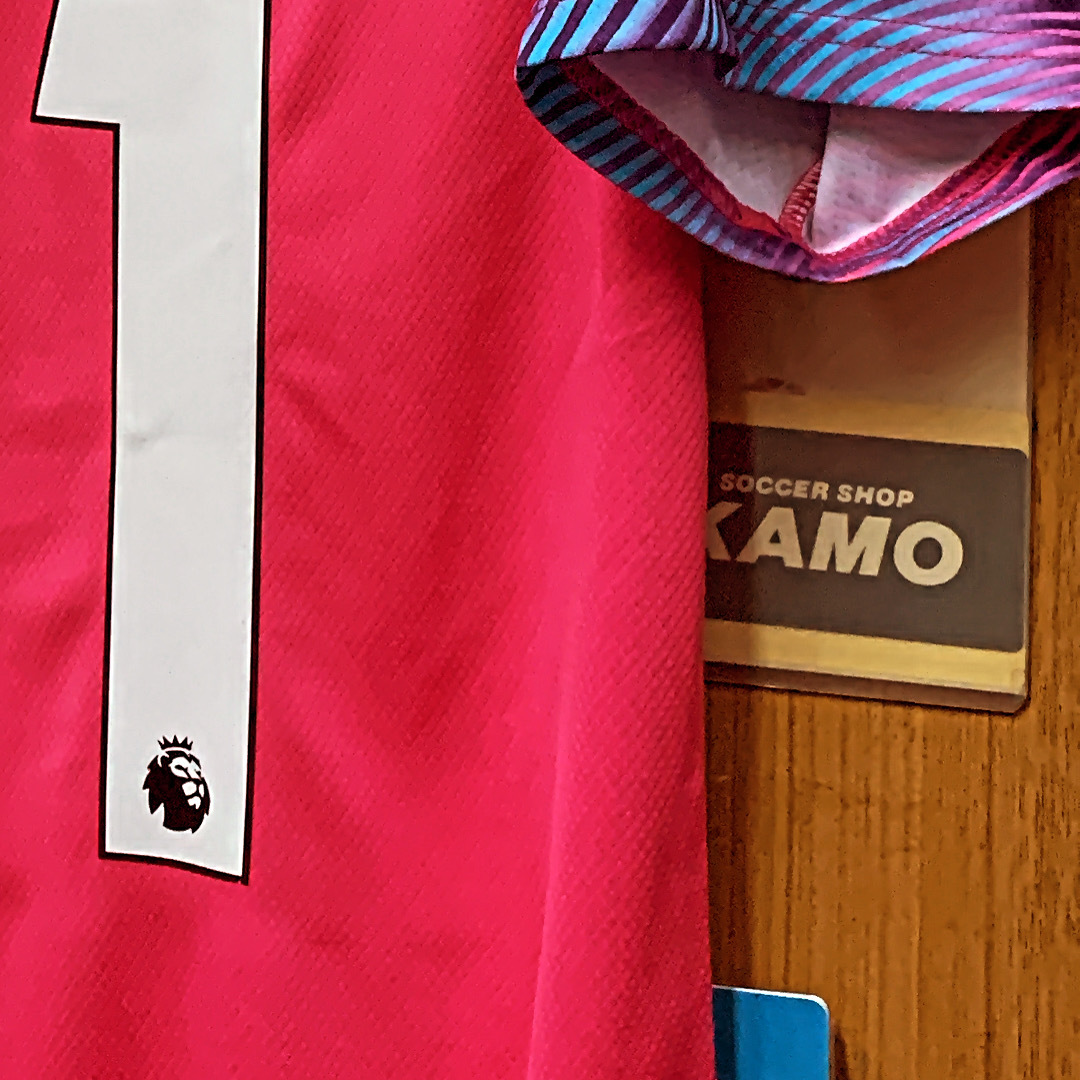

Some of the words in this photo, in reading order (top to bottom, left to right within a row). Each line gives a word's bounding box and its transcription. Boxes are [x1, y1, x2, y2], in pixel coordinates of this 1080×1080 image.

[720, 473, 830, 500] SOCCER
[837, 484, 914, 508] SHOP
[706, 500, 963, 586] KAMO
